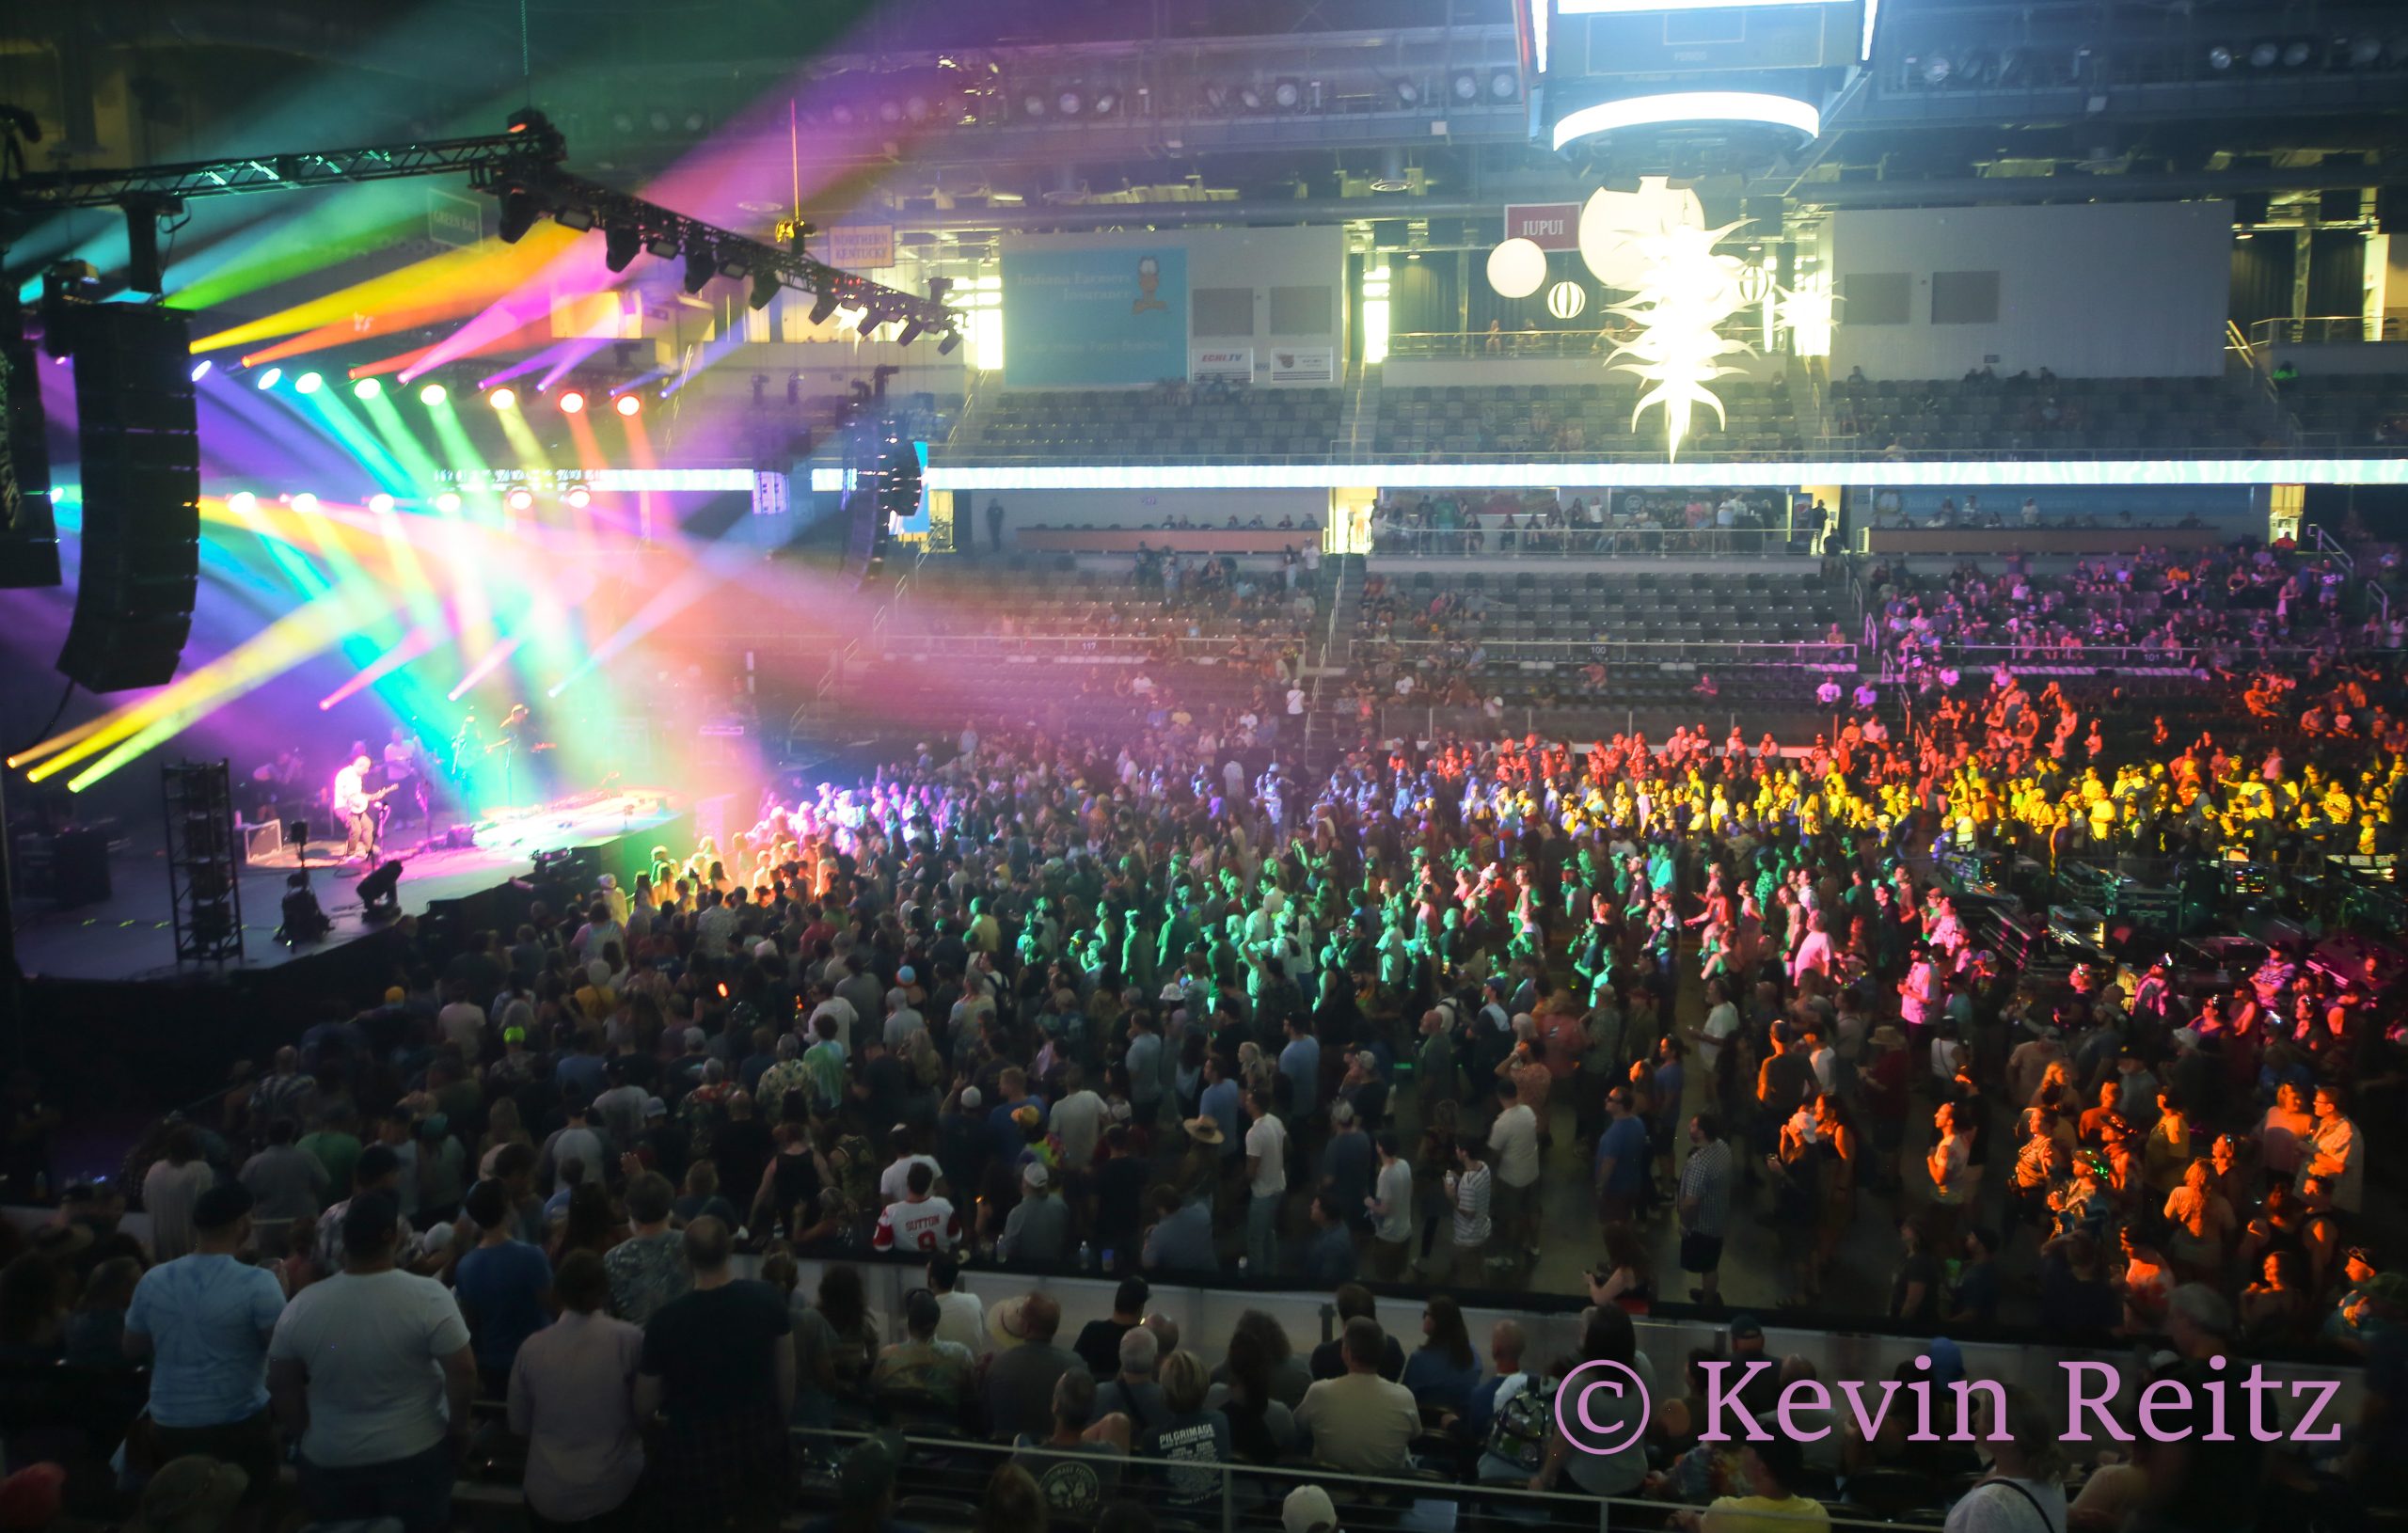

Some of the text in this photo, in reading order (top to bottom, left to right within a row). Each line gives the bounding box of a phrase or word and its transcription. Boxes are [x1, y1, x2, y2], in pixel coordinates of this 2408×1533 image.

[1522, 219, 1564, 236] IUPUI
[834, 233, 888, 245] NORTHERN
[835, 247, 888, 260] KENTUCKY
[1017, 271, 1131, 286] Indiana Farmers
[1591, 646, 1607, 655] 100
[2144, 653, 2160, 662] 101
[906, 1215, 940, 1231] SUTTON
[1159, 1424, 1213, 1445] PILGRIMAGE
